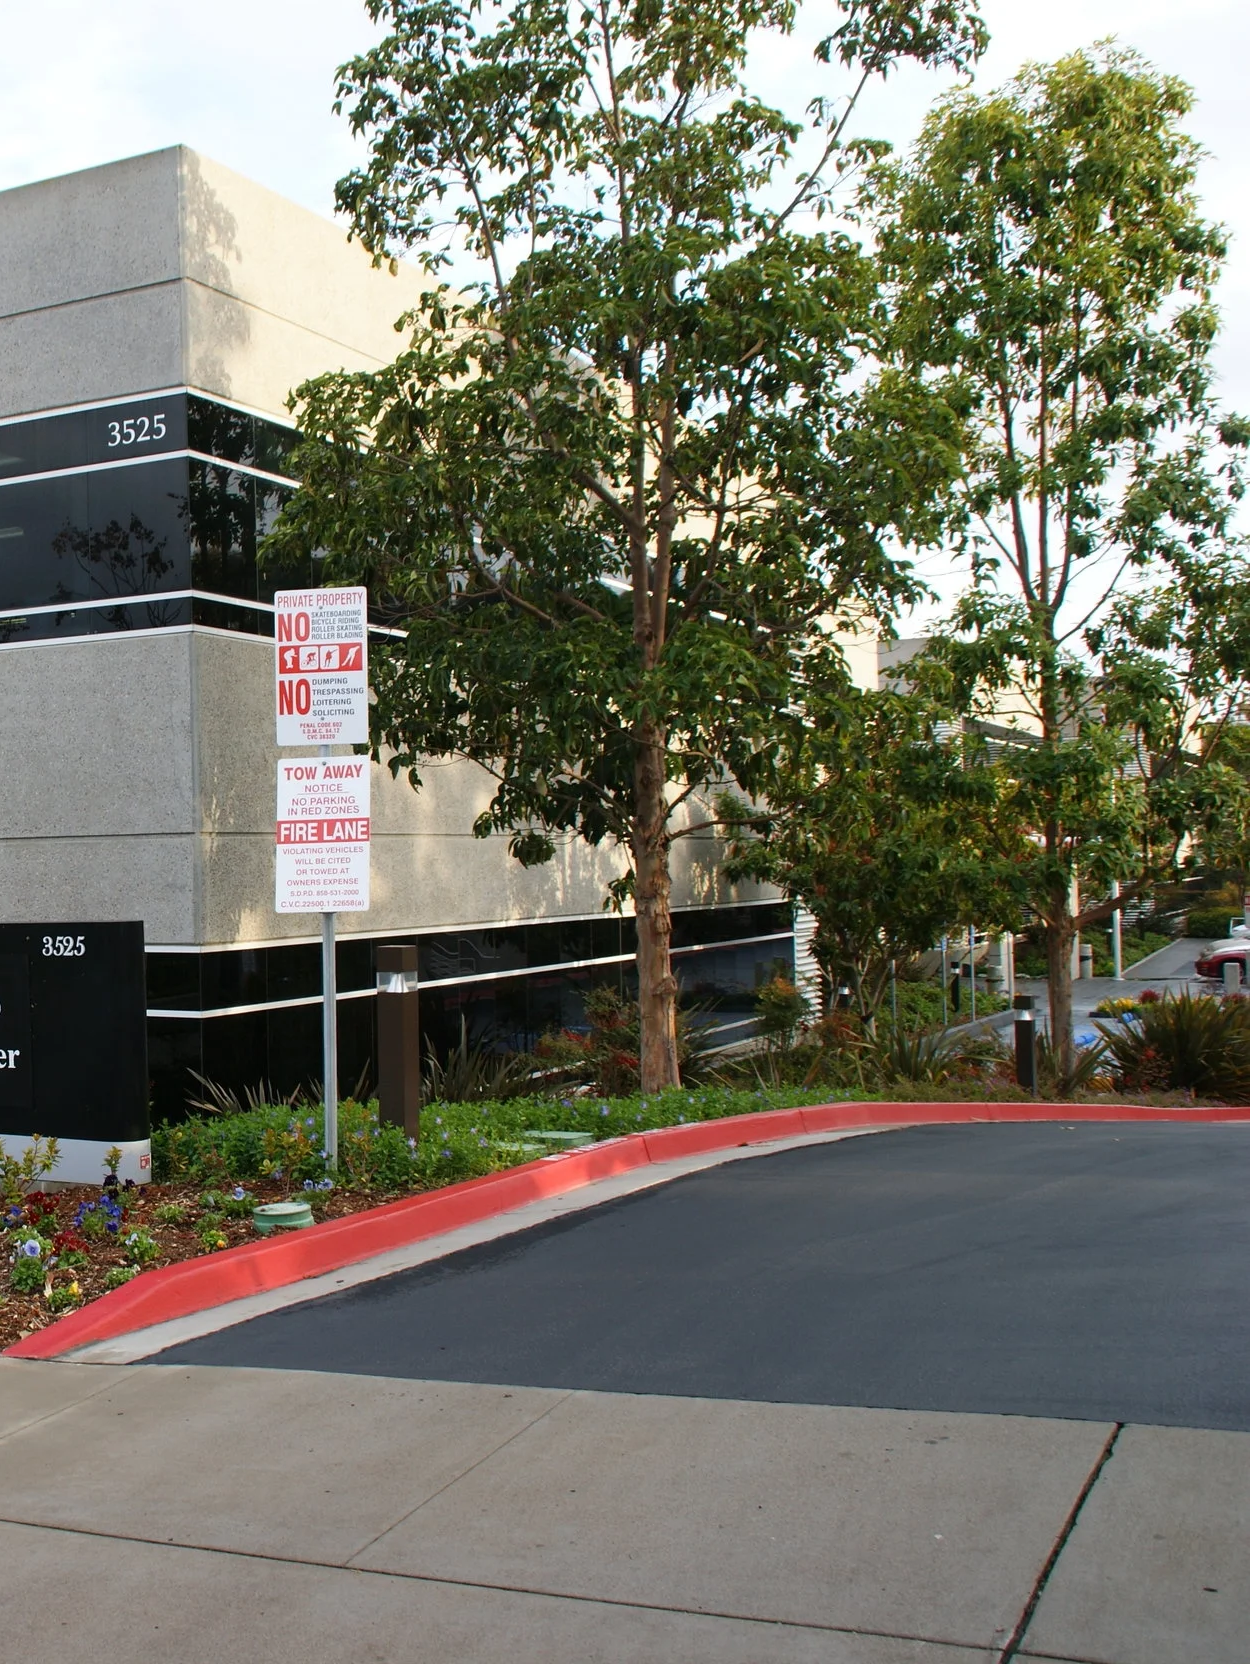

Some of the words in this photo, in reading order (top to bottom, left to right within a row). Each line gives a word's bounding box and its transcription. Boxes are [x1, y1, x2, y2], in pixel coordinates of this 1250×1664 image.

[108, 414, 166, 447] 3525
[278, 595, 313, 608] PRIVATE
[317, 592, 363, 606] PROPERTY
[311, 610, 361, 618] SKATEBOARDING
[278, 612, 310, 642] NO
[312, 687, 364, 695] TRESPASSING
[279, 679, 310, 715] NO
[313, 698, 351, 706] LOITERING
[313, 708, 354, 716] SOLICITING
[284, 766, 317, 780] TOW
[323, 764, 363, 779] AWAY
[305, 783, 342, 793] NOTICE
[292, 798, 307, 806] NO
[310, 796, 355, 805] PARKING
[288, 808, 297, 816] IN
[301, 807, 322, 815] RED
[325, 805, 359, 814] ZONES
[281, 823, 318, 842] FIRE
[323, 821, 367, 840] LANE
[326, 846, 363, 854] VEHICLES
[42, 936, 85, 956] 3525
